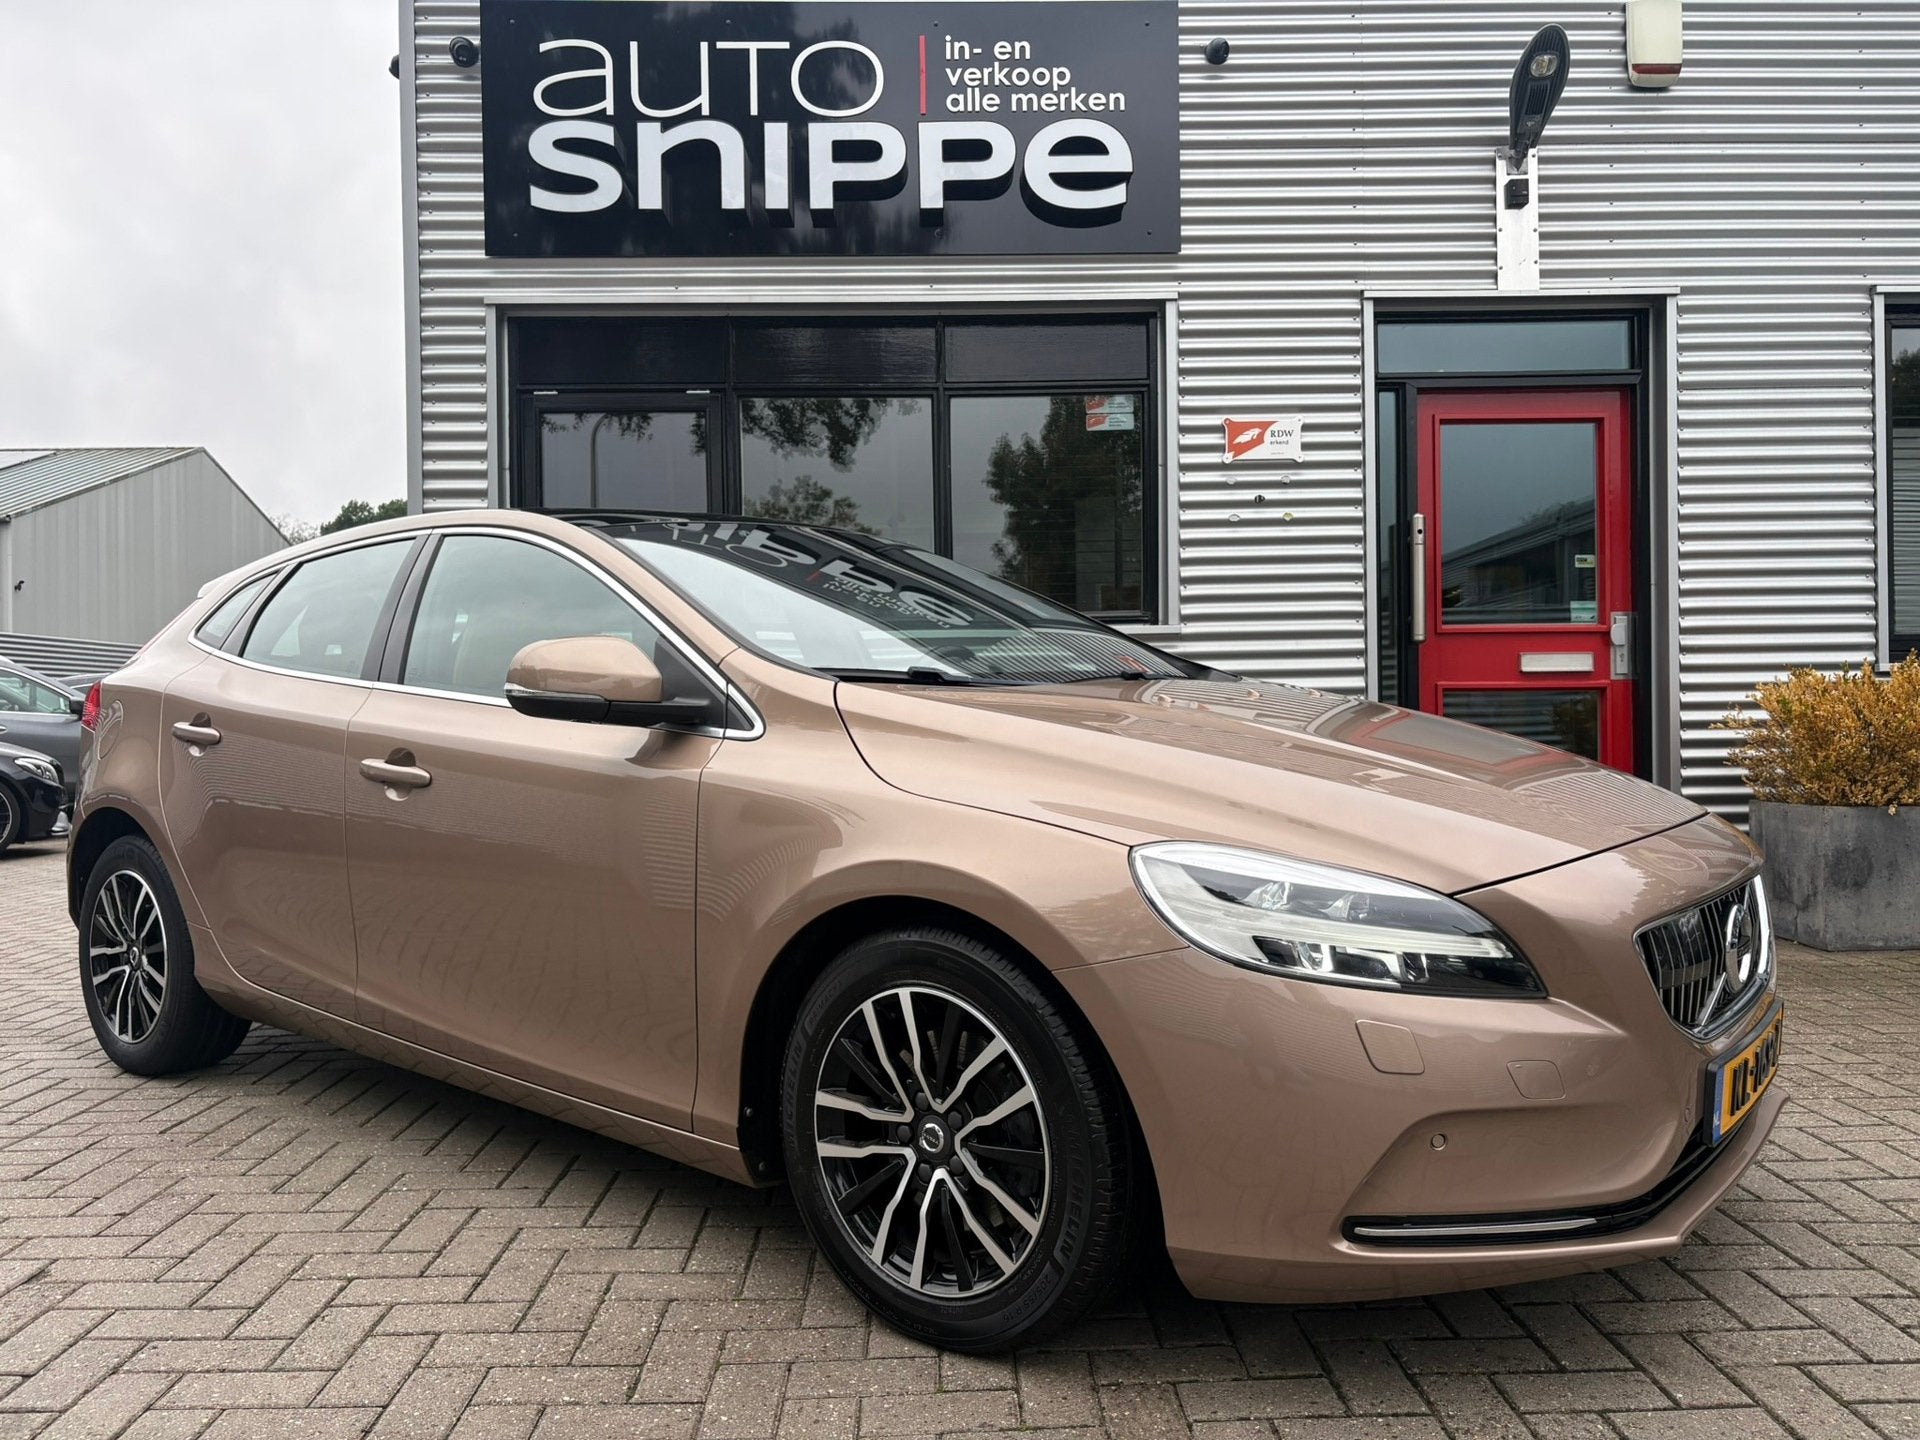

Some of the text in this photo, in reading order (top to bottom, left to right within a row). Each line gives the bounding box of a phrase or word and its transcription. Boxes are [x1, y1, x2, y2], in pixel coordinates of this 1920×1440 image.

[944, 35, 1032, 61] in- en
[944, 62, 1071, 92] verkoop
[944, 88, 1126, 113] alle merken
[1270, 429, 1294, 438] RDW
